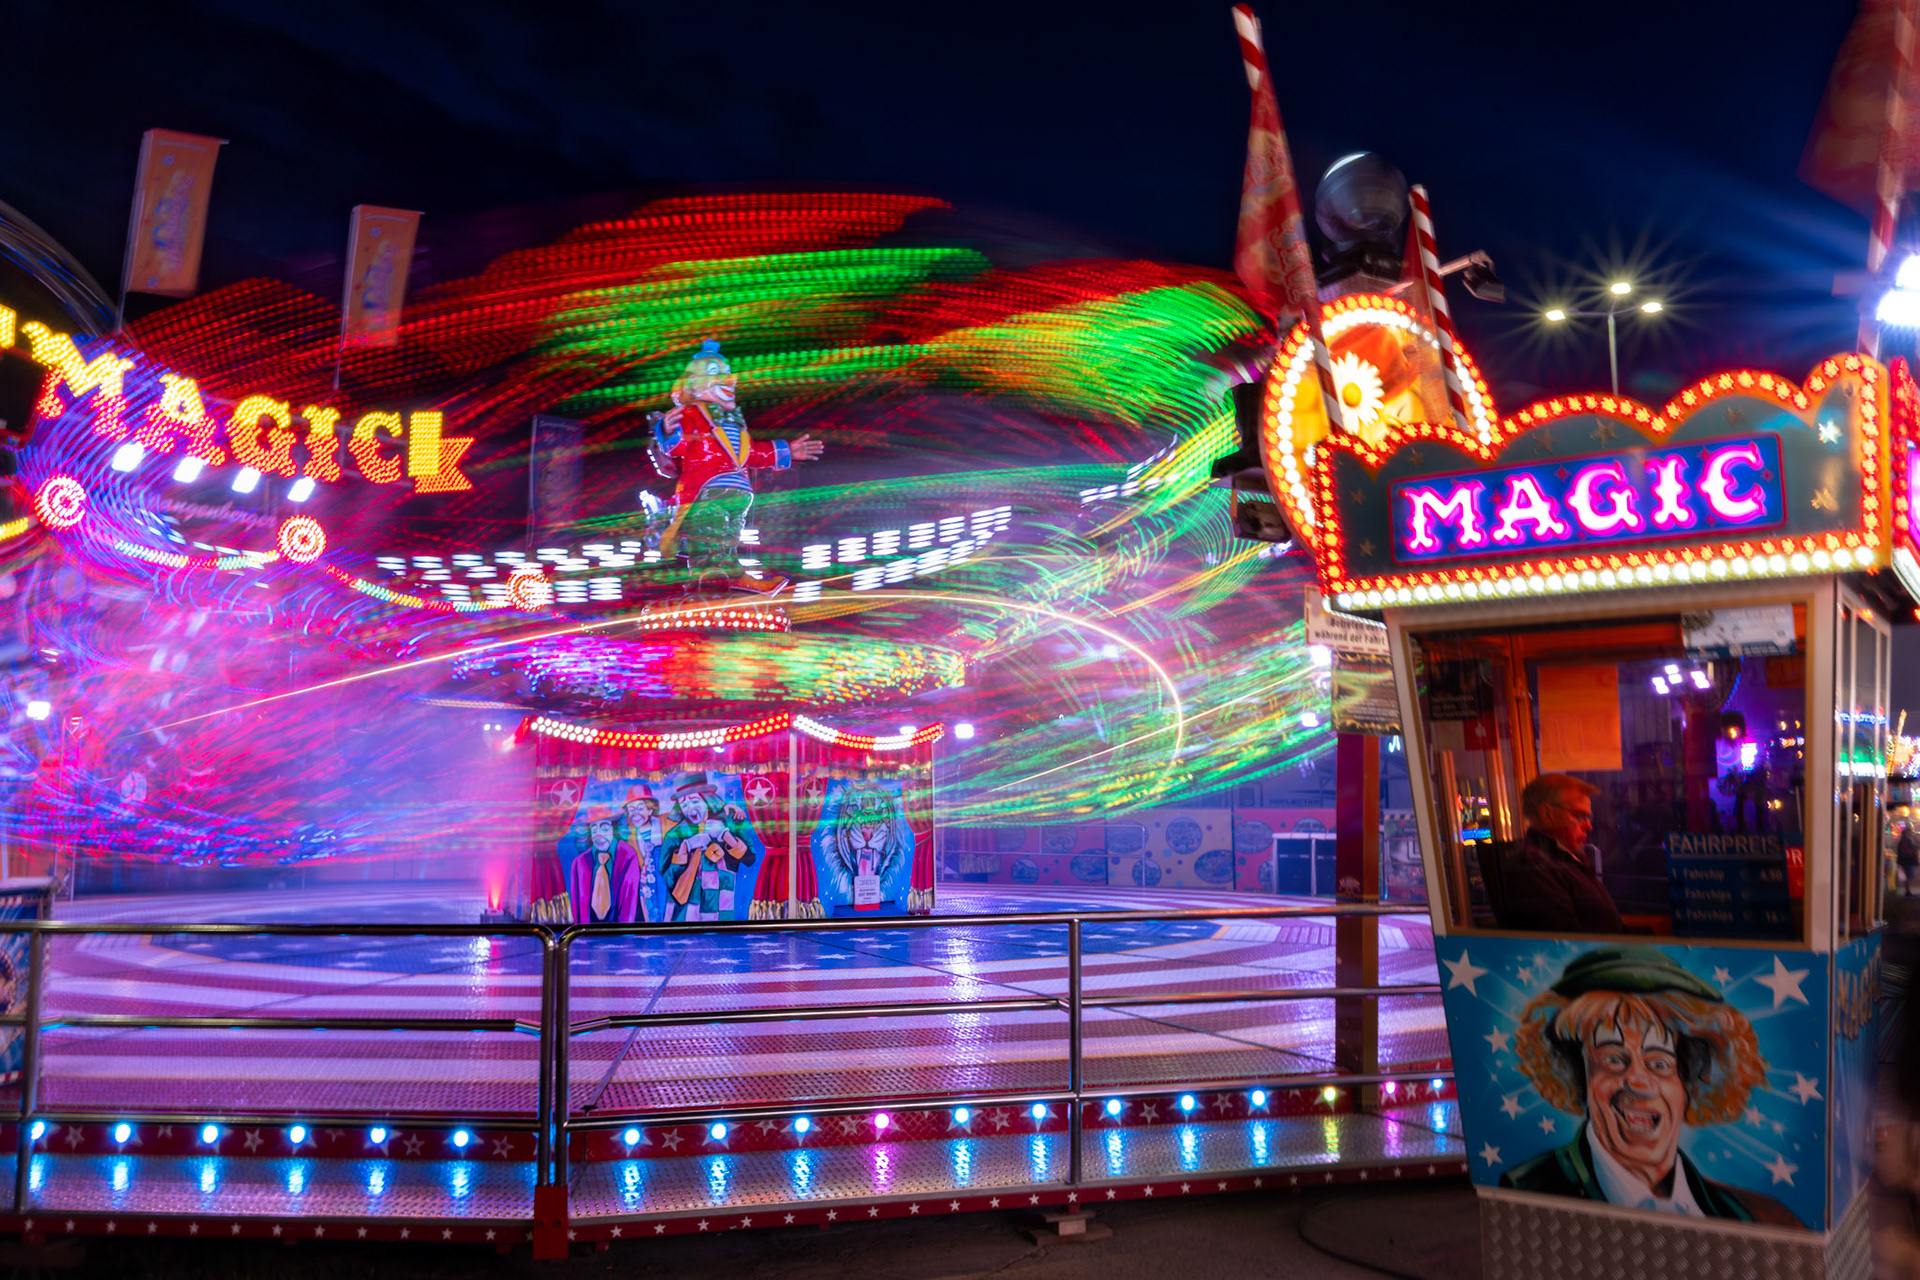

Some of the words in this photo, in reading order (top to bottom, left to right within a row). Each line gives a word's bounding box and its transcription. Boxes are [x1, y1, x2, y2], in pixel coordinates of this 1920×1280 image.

[1400, 441, 1767, 555] MAGIC
[1314, 631, 1348, 642] während
[1350, 634, 1363, 644] der
[1365, 635, 1385, 646] Fahrt
[1668, 833, 1781, 856] FAHRPREIS
